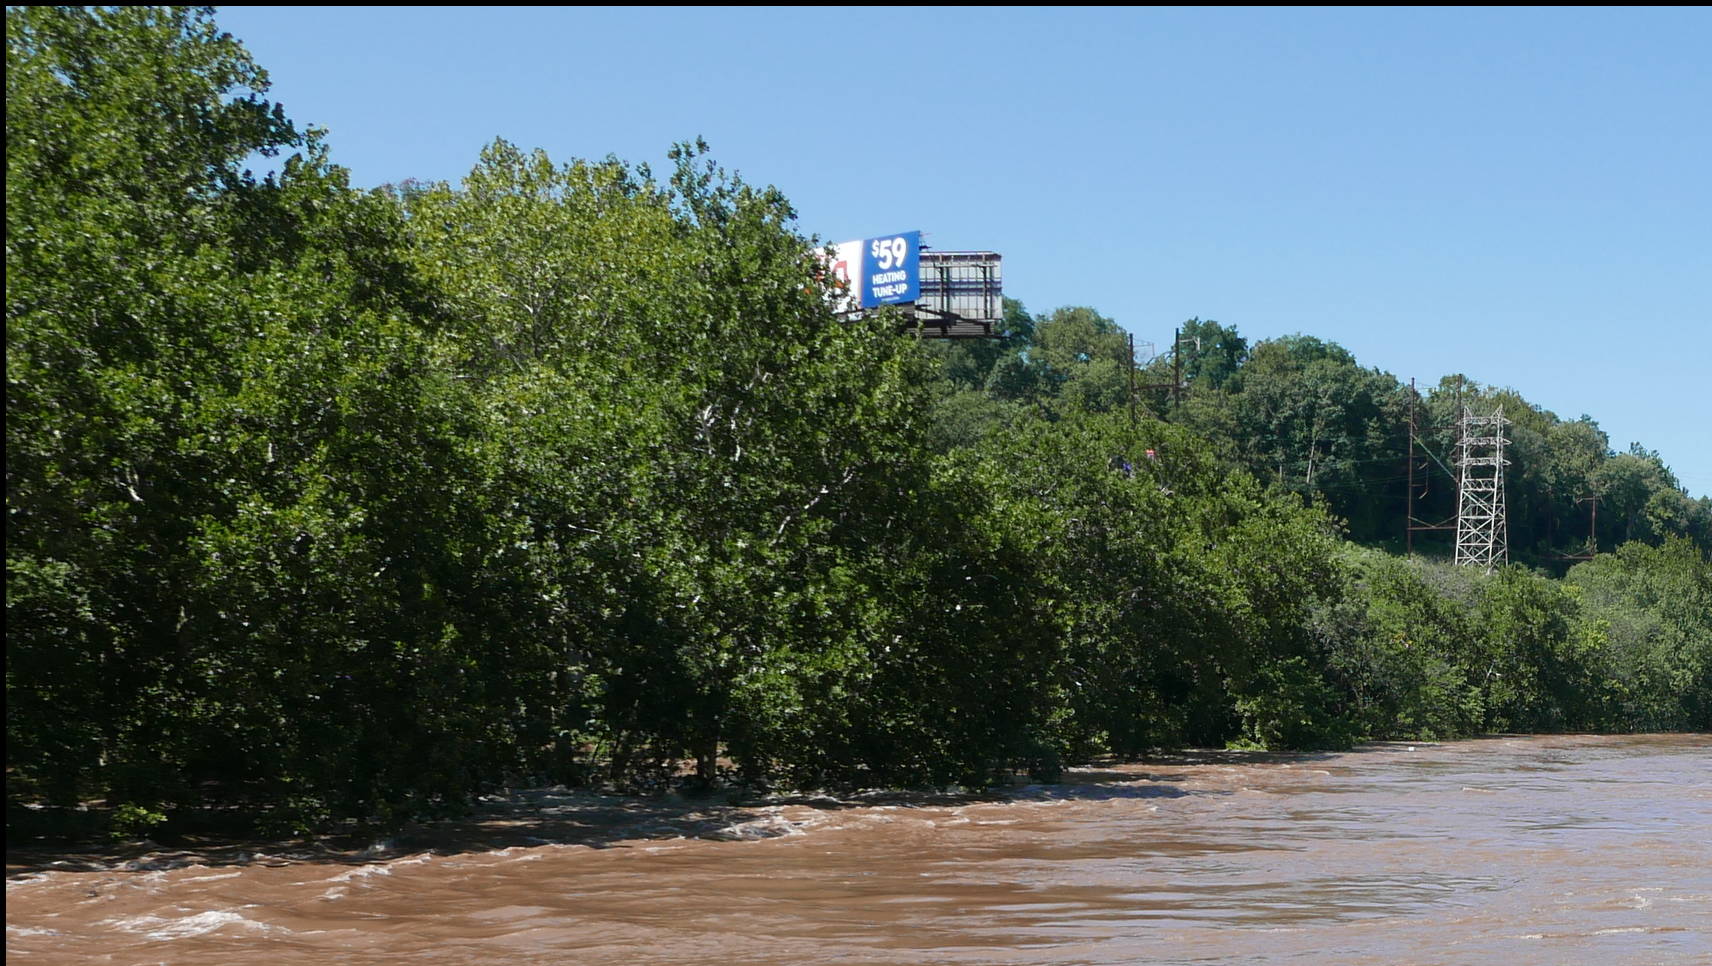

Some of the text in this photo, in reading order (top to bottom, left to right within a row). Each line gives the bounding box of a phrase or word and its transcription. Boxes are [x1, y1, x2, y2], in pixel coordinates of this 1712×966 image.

[872, 237, 907, 270] $59
[873, 270, 907, 285] HEATING
[873, 283, 907, 298] TUNE-UP
